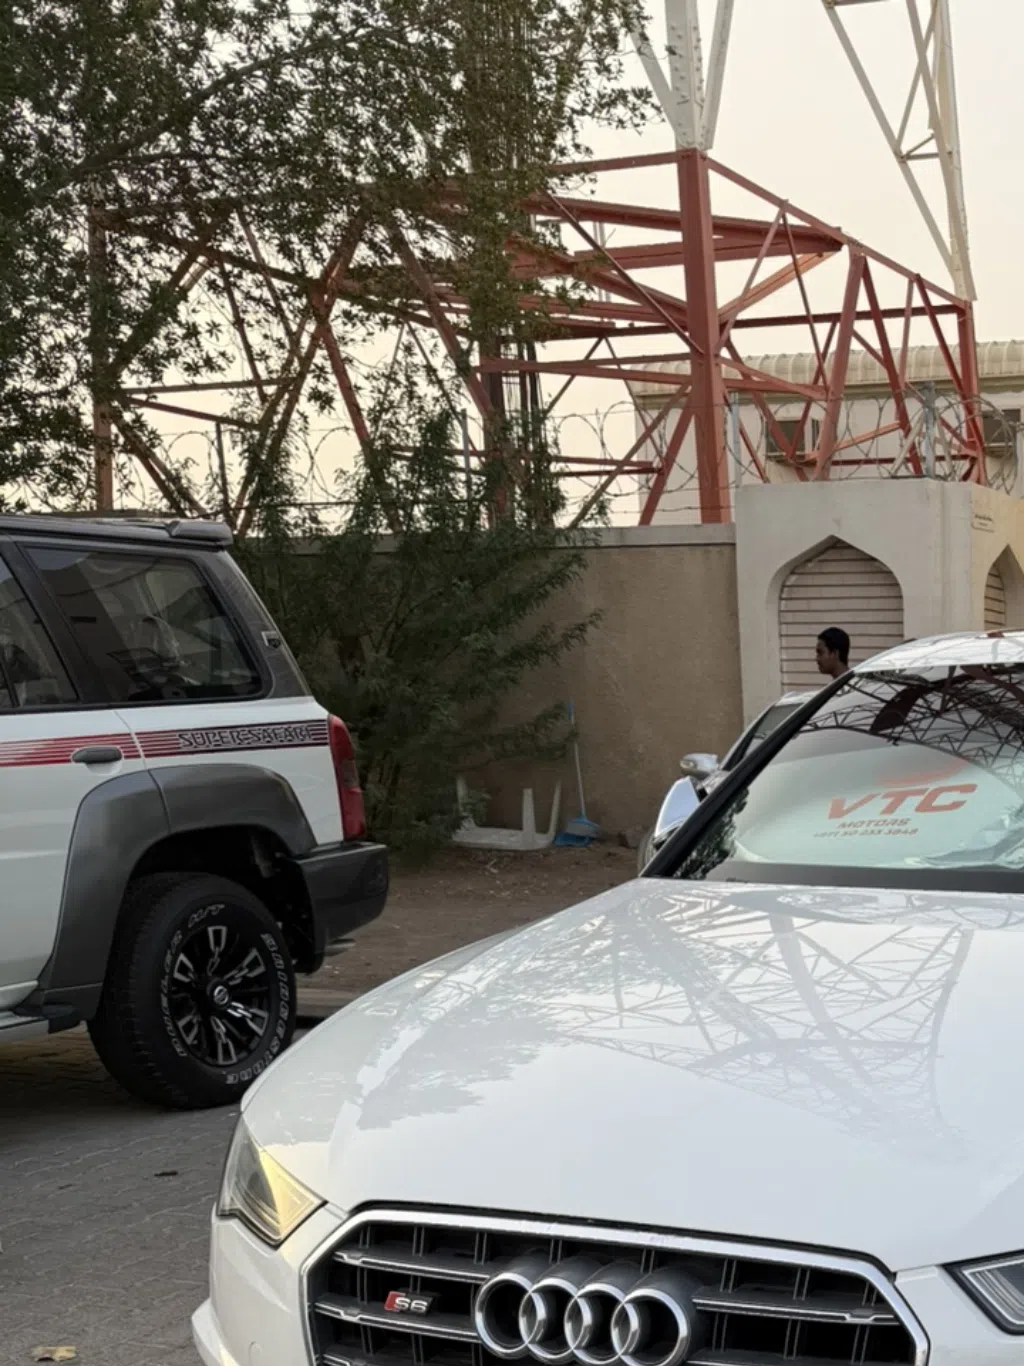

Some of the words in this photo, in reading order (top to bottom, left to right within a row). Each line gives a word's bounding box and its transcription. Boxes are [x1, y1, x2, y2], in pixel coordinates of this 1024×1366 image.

[178, 730, 246, 749] SUPER
[248, 725, 314, 745] SAFARI
[828, 783, 978, 820] VTC
[836, 818, 911, 829] MOTORS
[395, 1297, 428, 1313] S6
